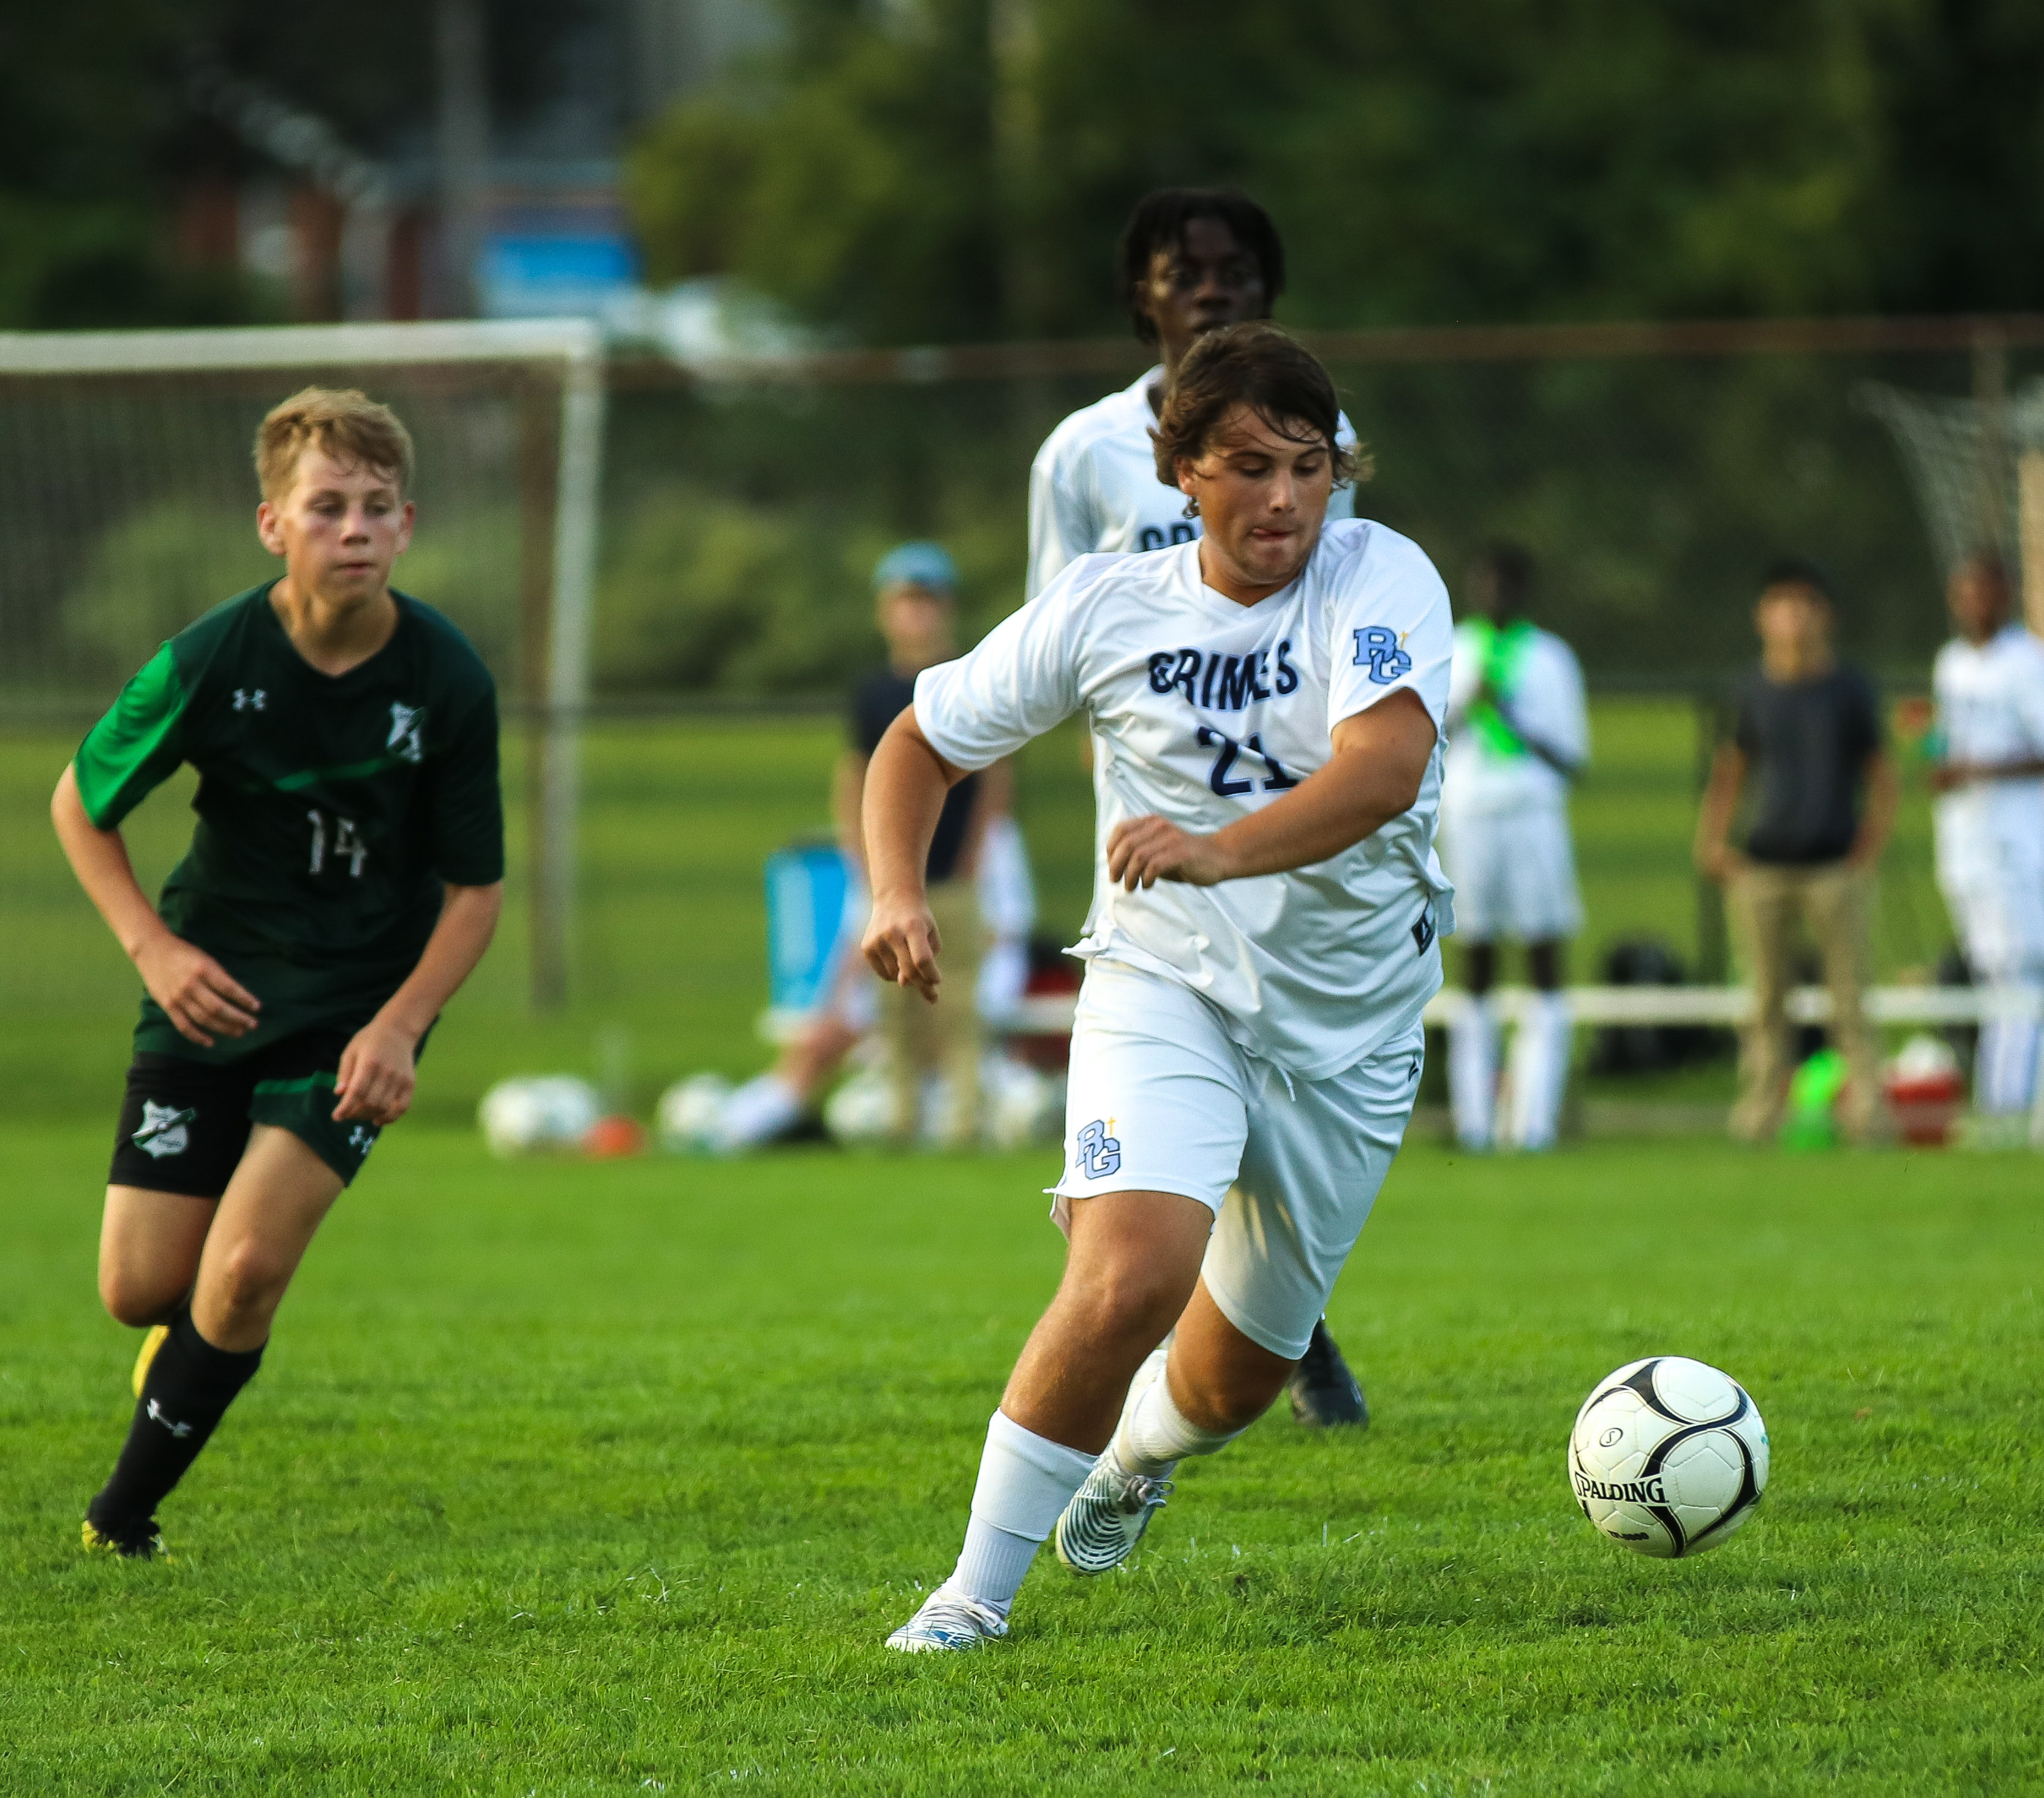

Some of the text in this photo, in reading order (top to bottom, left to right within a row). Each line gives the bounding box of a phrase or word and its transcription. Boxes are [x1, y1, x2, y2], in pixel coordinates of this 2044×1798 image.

[1149, 639, 1298, 710] GRIMES
[1197, 725, 1302, 796] 21
[307, 809, 368, 877] 14
[1575, 1471, 1666, 1503] SPALDING
